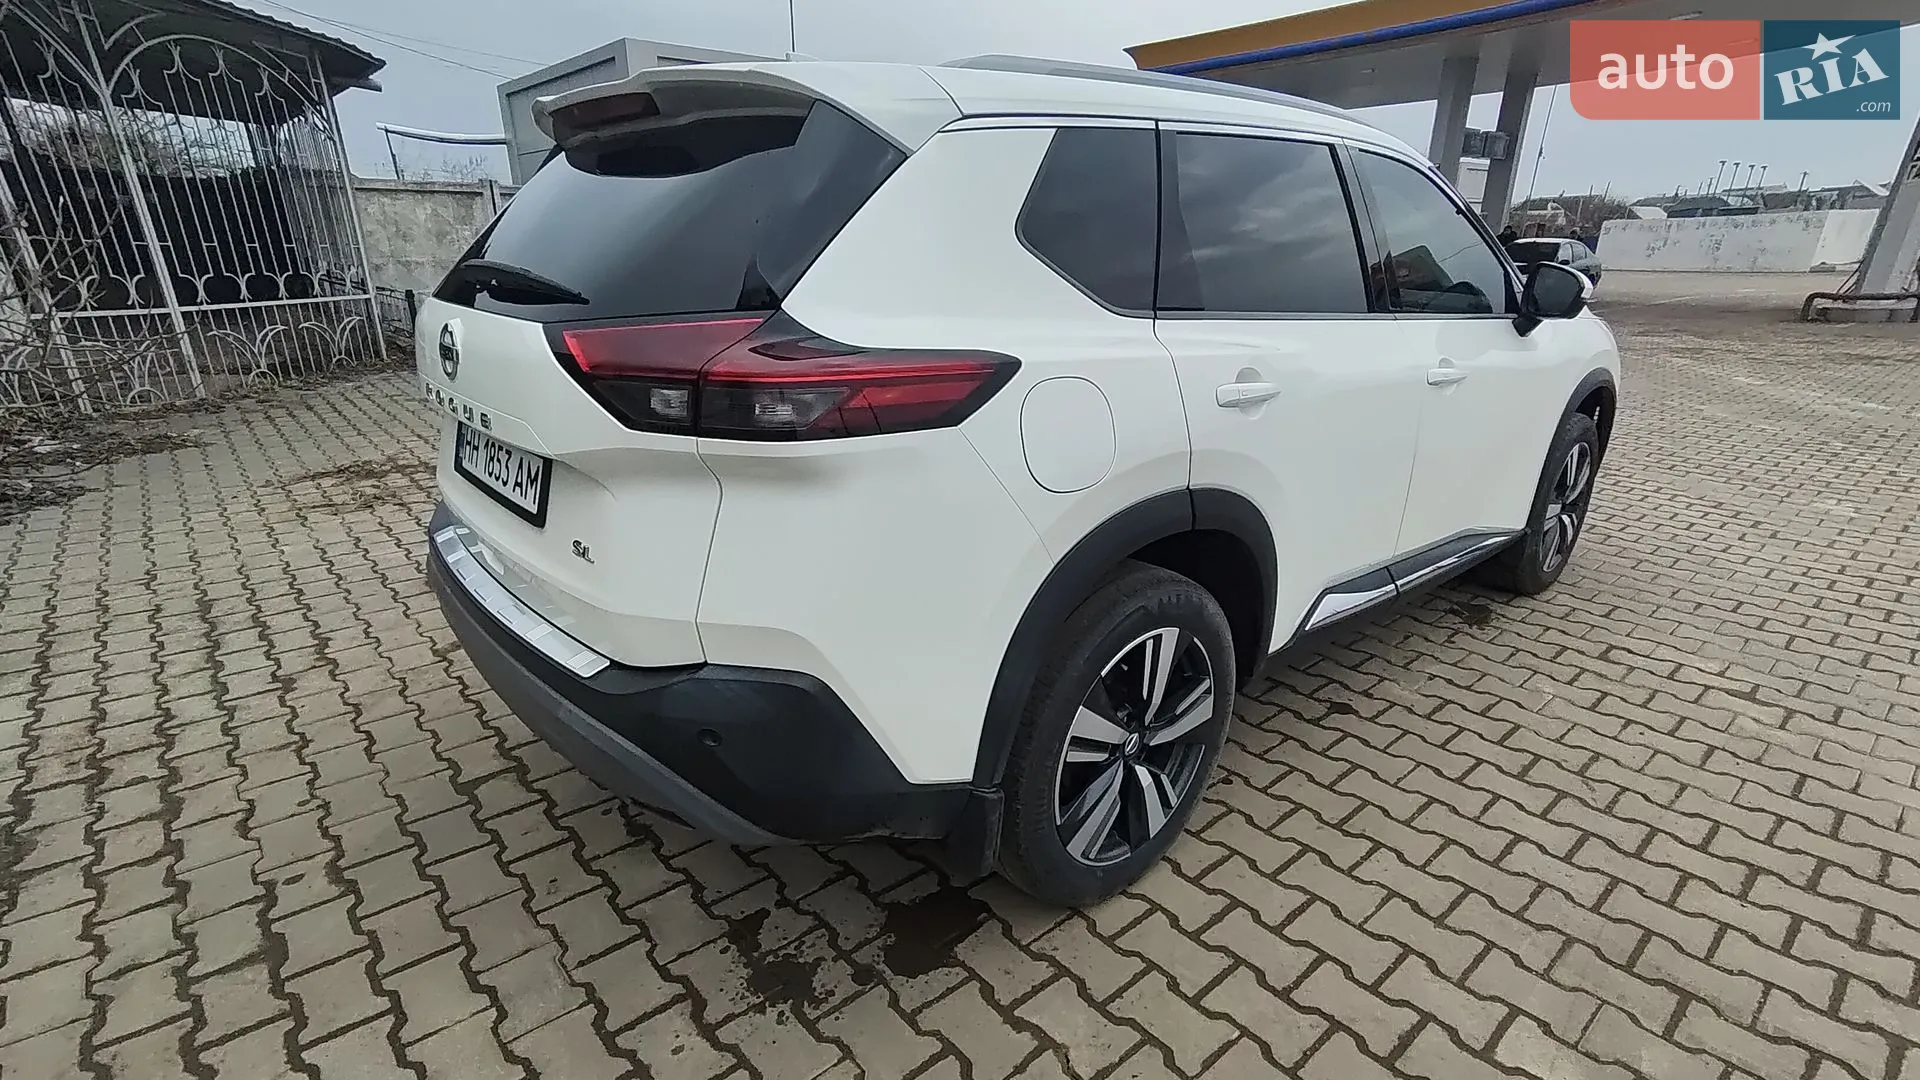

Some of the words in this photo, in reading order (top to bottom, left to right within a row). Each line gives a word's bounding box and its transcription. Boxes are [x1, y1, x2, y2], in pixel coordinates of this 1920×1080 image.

[425, 382, 492, 431] ROGUE
[463, 426, 481, 469] HH
[483, 437, 513, 488] 1853
[512, 456, 541, 506] AM
[572, 539, 595, 564] SL
